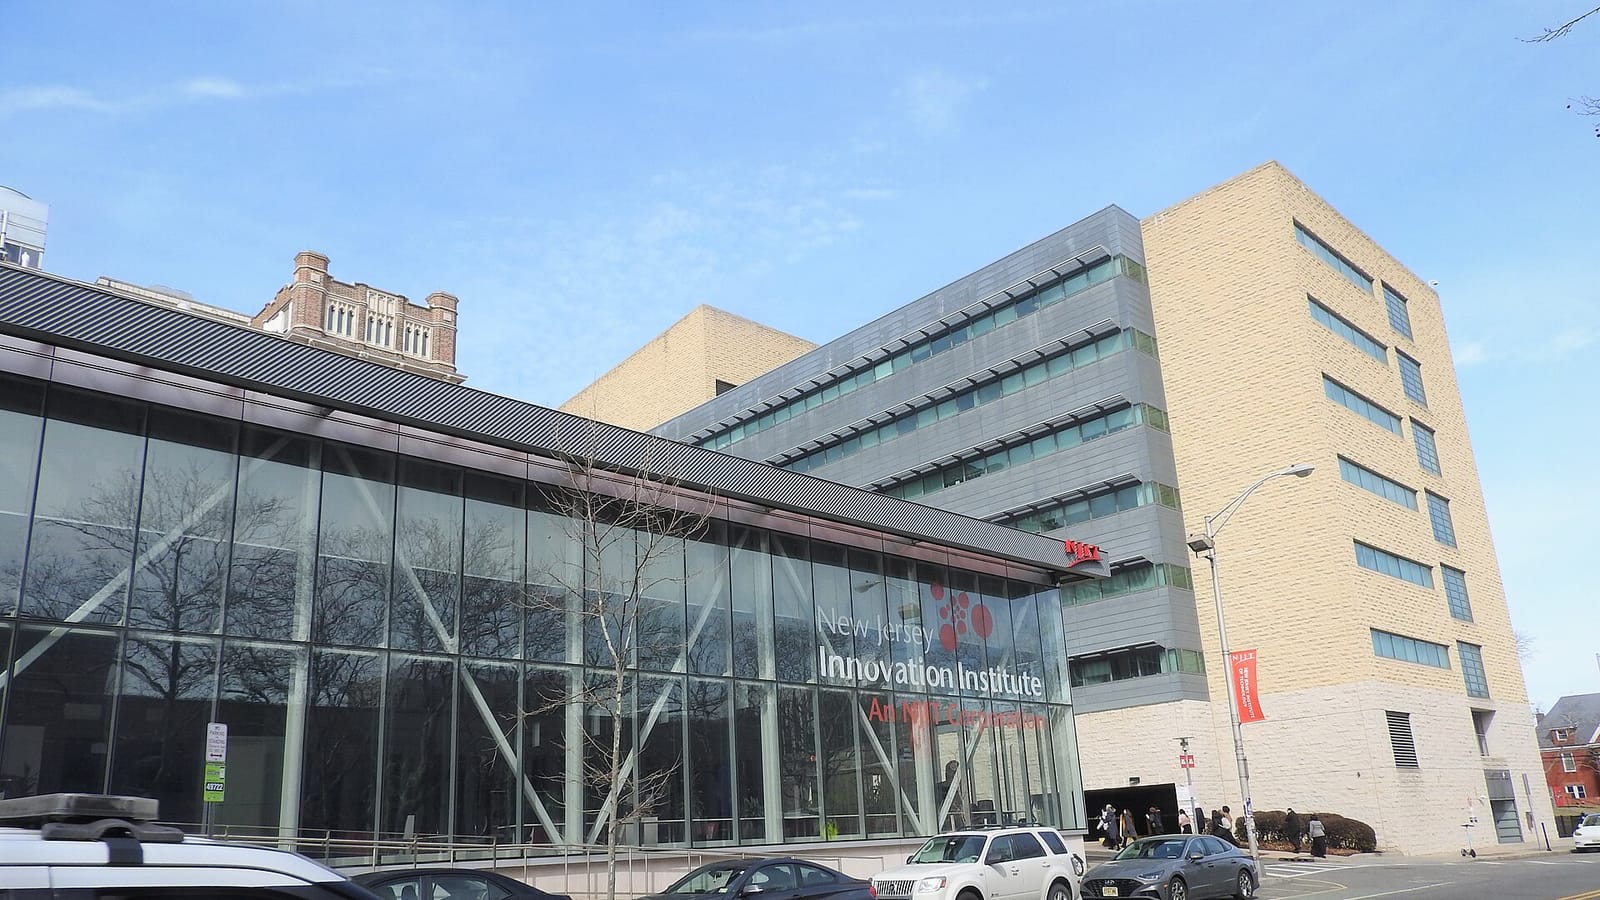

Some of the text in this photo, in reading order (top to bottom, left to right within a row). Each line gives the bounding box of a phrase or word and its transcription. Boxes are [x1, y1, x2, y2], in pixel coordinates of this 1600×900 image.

[816, 605, 934, 654] New Jersey
[819, 645, 1042, 697] Innovation Institute
[868, 698, 895, 722] An
